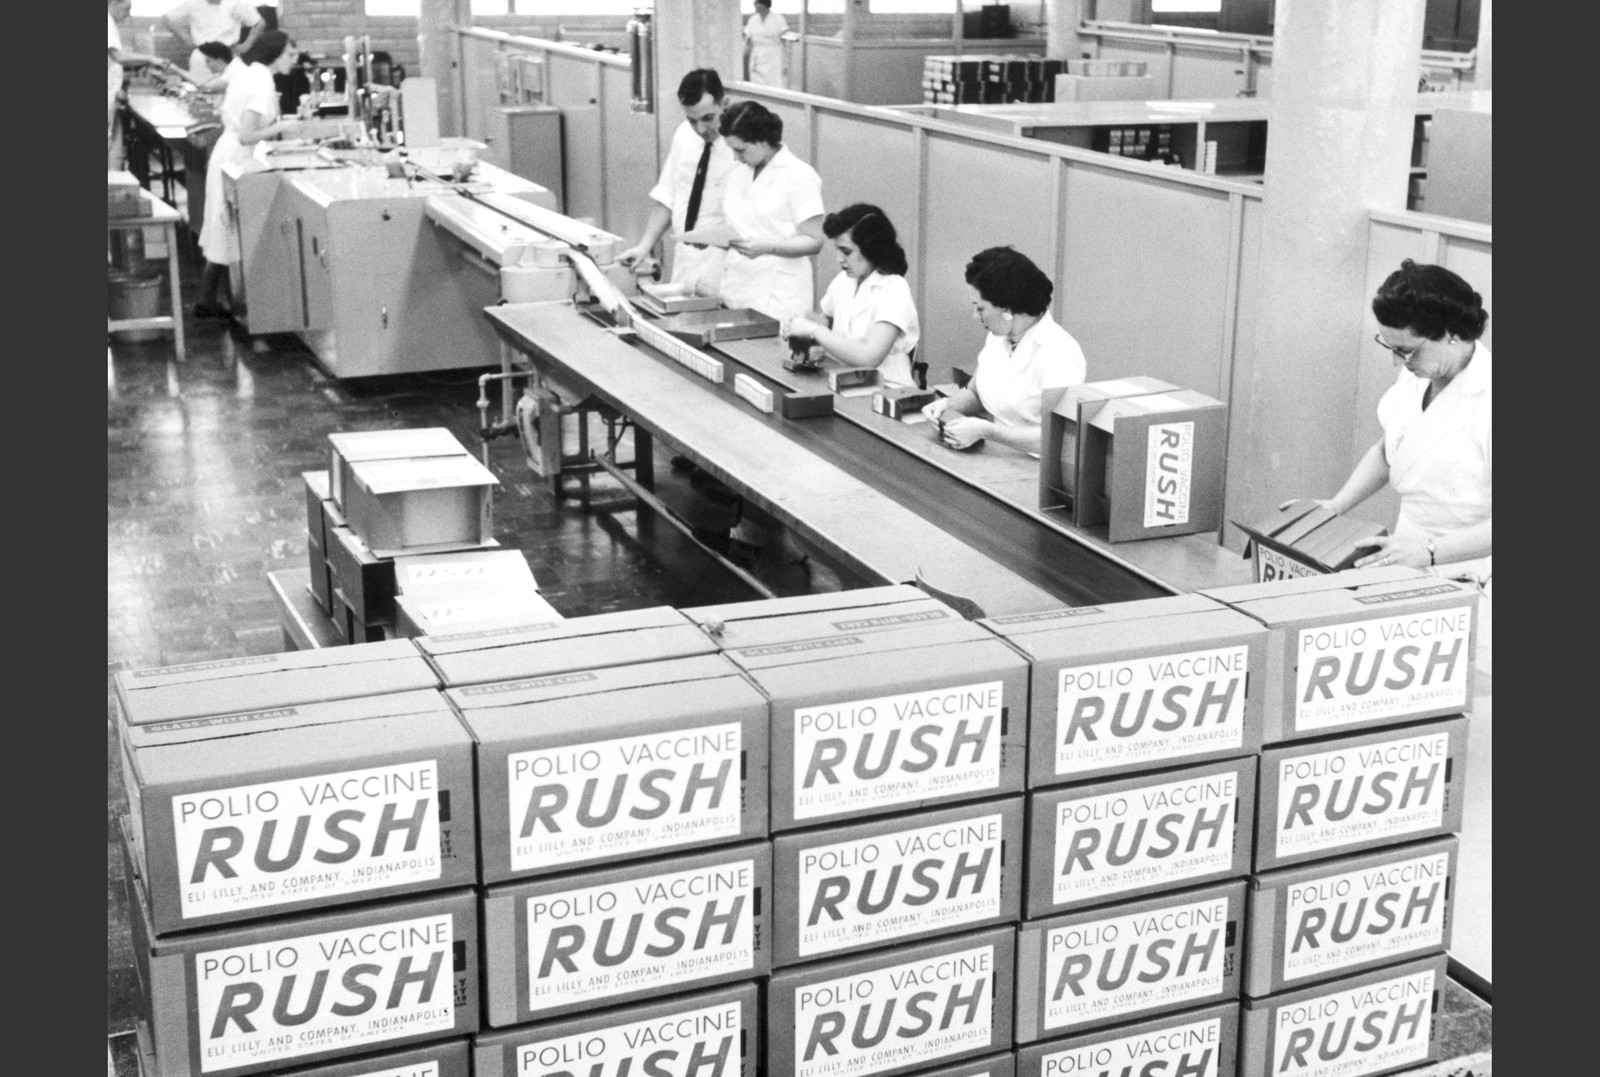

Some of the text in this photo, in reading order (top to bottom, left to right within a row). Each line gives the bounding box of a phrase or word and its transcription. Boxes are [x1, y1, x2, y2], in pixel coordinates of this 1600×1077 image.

[1156, 429, 1179, 520] RUSH
[1304, 614, 1467, 654] POLIO VACCINE
[1064, 653, 1244, 694] POLIO VACCINE
[1303, 638, 1464, 704] RUSH
[801, 689, 998, 735] POLIO VACCINE
[1064, 678, 1240, 746] RUSH
[516, 731, 736, 781] POLIO VACCINE
[802, 715, 995, 790] RUSH
[1106, 745, 1124, 755] AND
[1285, 740, 1445, 783] POLIO VACCINE
[182, 769, 430, 824] POLIO VACCINE
[519, 758, 733, 839] RUSH
[799, 796, 814, 807] ELI
[849, 787, 868, 798] AND
[930, 769, 996, 786] INDIANAPOLIS
[1062, 780, 1233, 826] POLIO VACCINE
[1284, 763, 1441, 831] RUSH
[190, 799, 428, 885] RUSH
[517, 846, 533, 857] ELI
[539, 841, 566, 854] LILLY
[572, 836, 594, 847] AND
[663, 815, 736, 833] INDIANAPOLIS
[805, 822, 998, 875] POLIO VACCINE
[1061, 804, 1230, 877] RUSH
[187, 892, 205, 904] ELI
[212, 887, 242, 900] LILLY
[250, 881, 274, 893] AND
[351, 859, 434, 878] INDIANAPOLIS
[534, 869, 749, 924] POLIO VACCINE
[807, 847, 995, 928] RUSH
[1101, 873, 1118, 883] AND
[1292, 860, 1445, 908] POLIO VACCINE
[538, 895, 746, 980] RUSH
[804, 933, 819, 944] ELI
[853, 922, 872, 933] AND
[933, 898, 996, 916] INDIANAPOLIS
[1052, 905, 1224, 953] POLIO VACCINE
[1291, 882, 1441, 955] RUSH
[204, 922, 446, 981] POLIO VACCINE
[535, 986, 551, 997] ELI
[557, 980, 583, 993] LILLY
[589, 975, 610, 986] AND
[678, 950, 749, 969] INDIANAPOLIS
[1052, 929, 1221, 1002] RUSH
[210, 951, 444, 1040] RUSH
[801, 953, 989, 1011] POLIO VACCINE
[1093, 998, 1110, 1008] AND
[1281, 977, 1432, 1029] POLIO VACCINE
[207, 1047, 225, 1058] ELI
[232, 1040, 261, 1054] LILLY
[268, 1034, 292, 1046] AND
[368, 1009, 449, 1029] INDIANAPOLIS
[524, 1010, 736, 1071] POLIO VACCINE
[803, 978, 986, 1061] RUSH
[1280, 999, 1428, 1073] RUSH
[846, 1055, 865, 1066] AND
[924, 1029, 988, 1048] INDIANAPOLIS
[1047, 1049, 1113, 1077] POLIO
[1127, 1026, 1217, 1060] VACCINE
